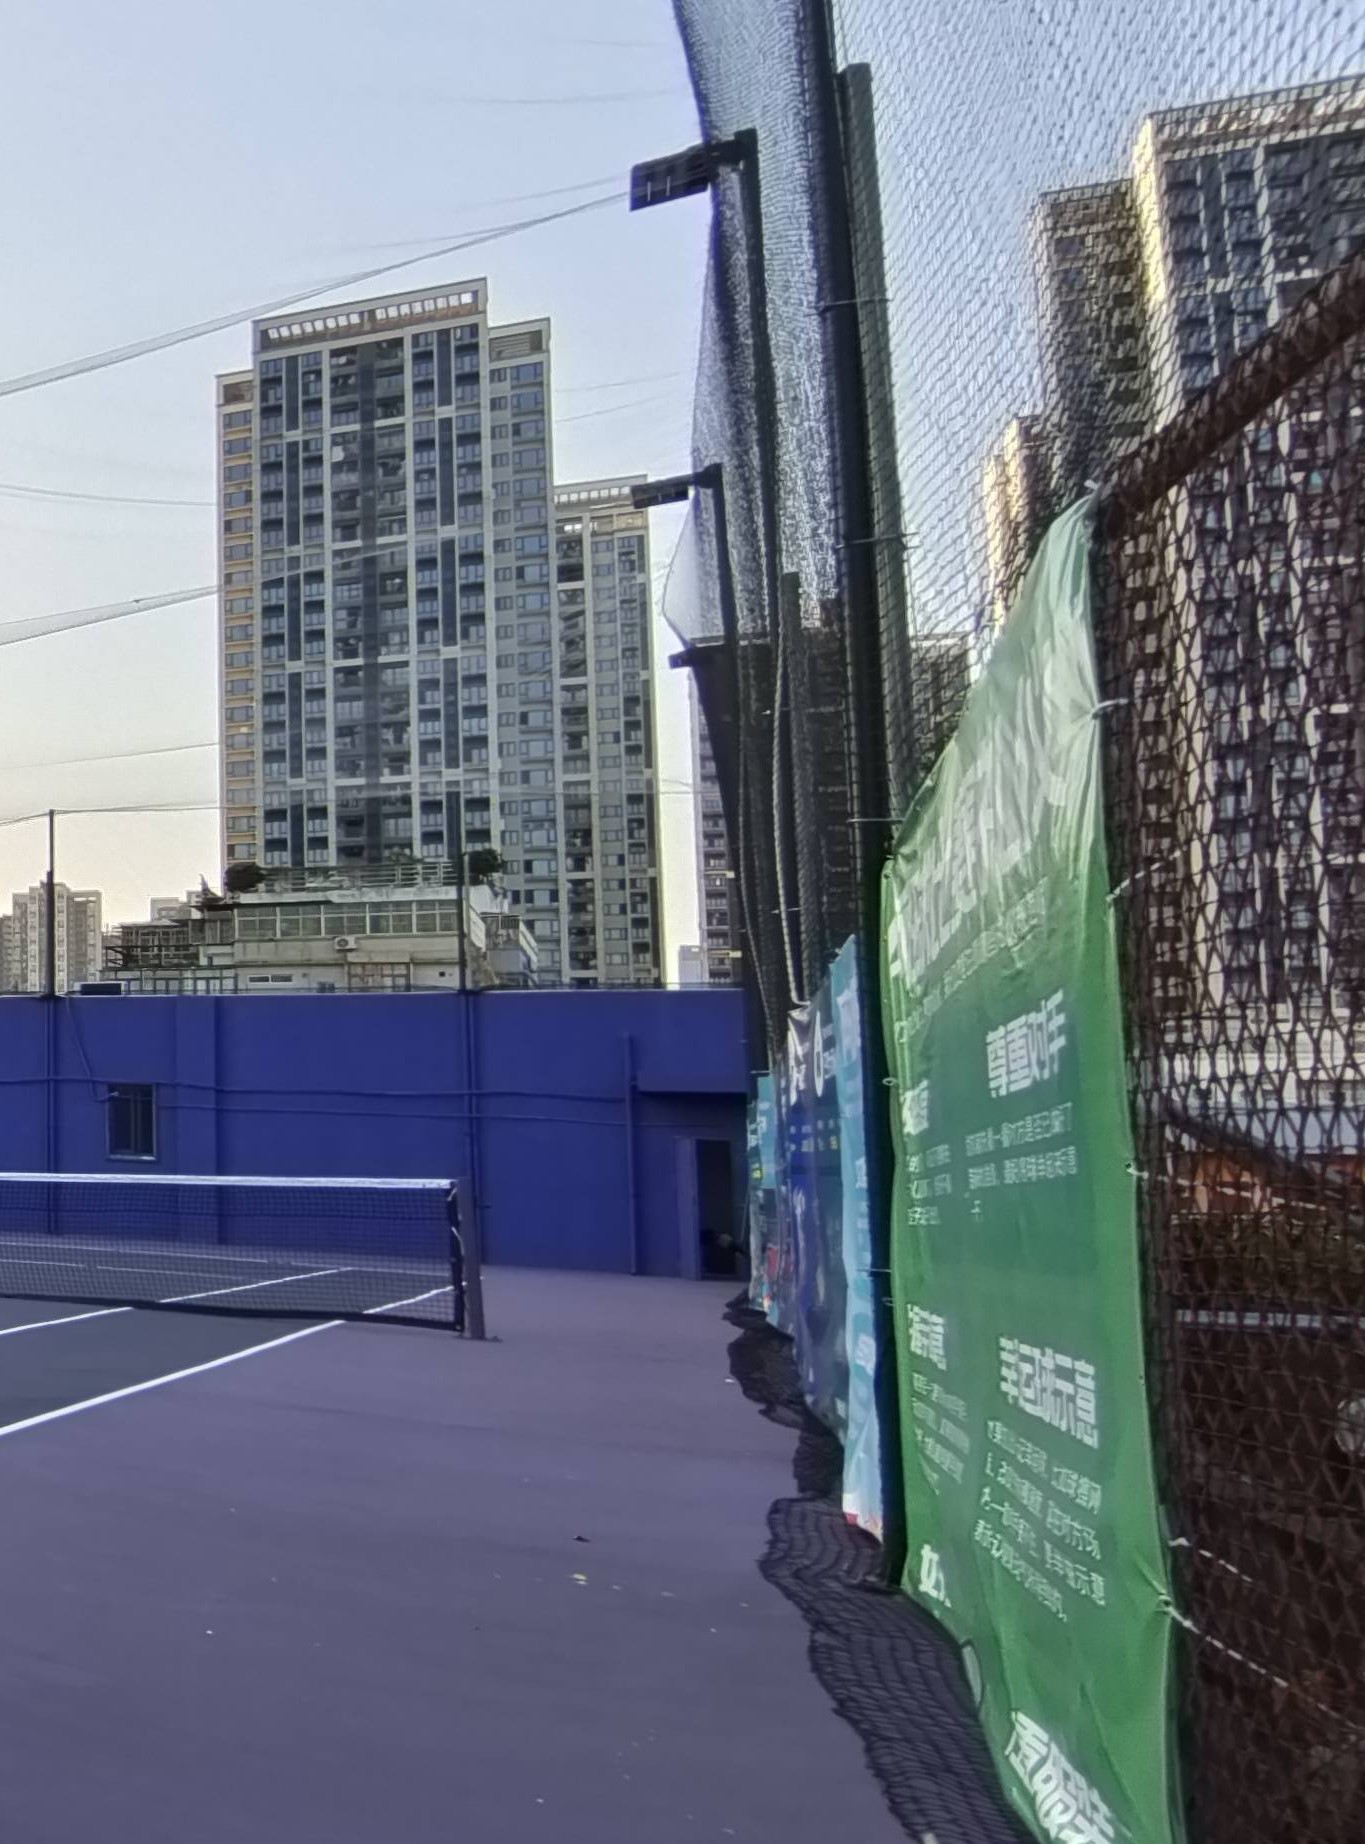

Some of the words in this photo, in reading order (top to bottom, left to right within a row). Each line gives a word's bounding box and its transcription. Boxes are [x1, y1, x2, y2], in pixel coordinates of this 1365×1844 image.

[985, 988, 1067, 1099] 尊重对手
[998, 1335, 1099, 1449] 幸运球示意
